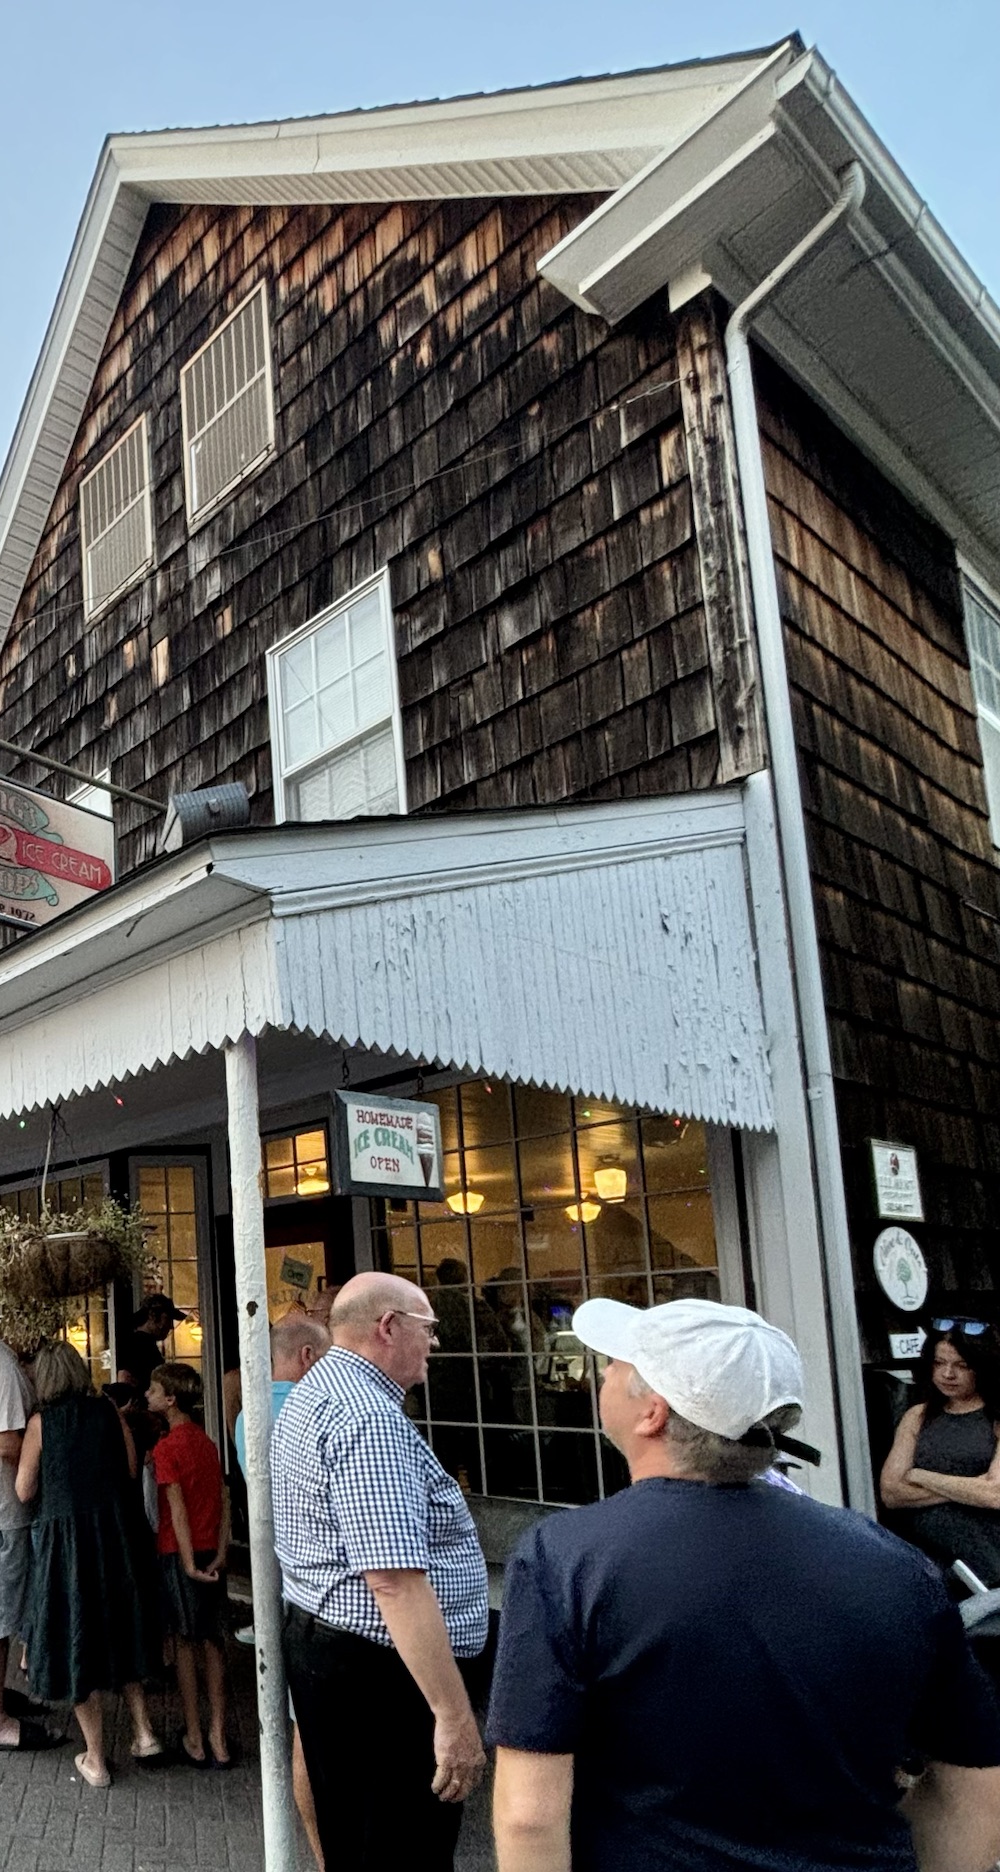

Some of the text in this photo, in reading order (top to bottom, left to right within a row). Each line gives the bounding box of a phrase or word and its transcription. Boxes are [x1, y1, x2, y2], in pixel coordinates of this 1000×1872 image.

[23, 841, 44, 864] ICE
[51, 852, 101, 884] CREAM
[356, 1109, 413, 1130] HOMEMADE
[354, 1127, 414, 1164] ICE CREAM
[370, 1156, 400, 1172] OPEN
[900, 1337, 921, 1355] CAFE
